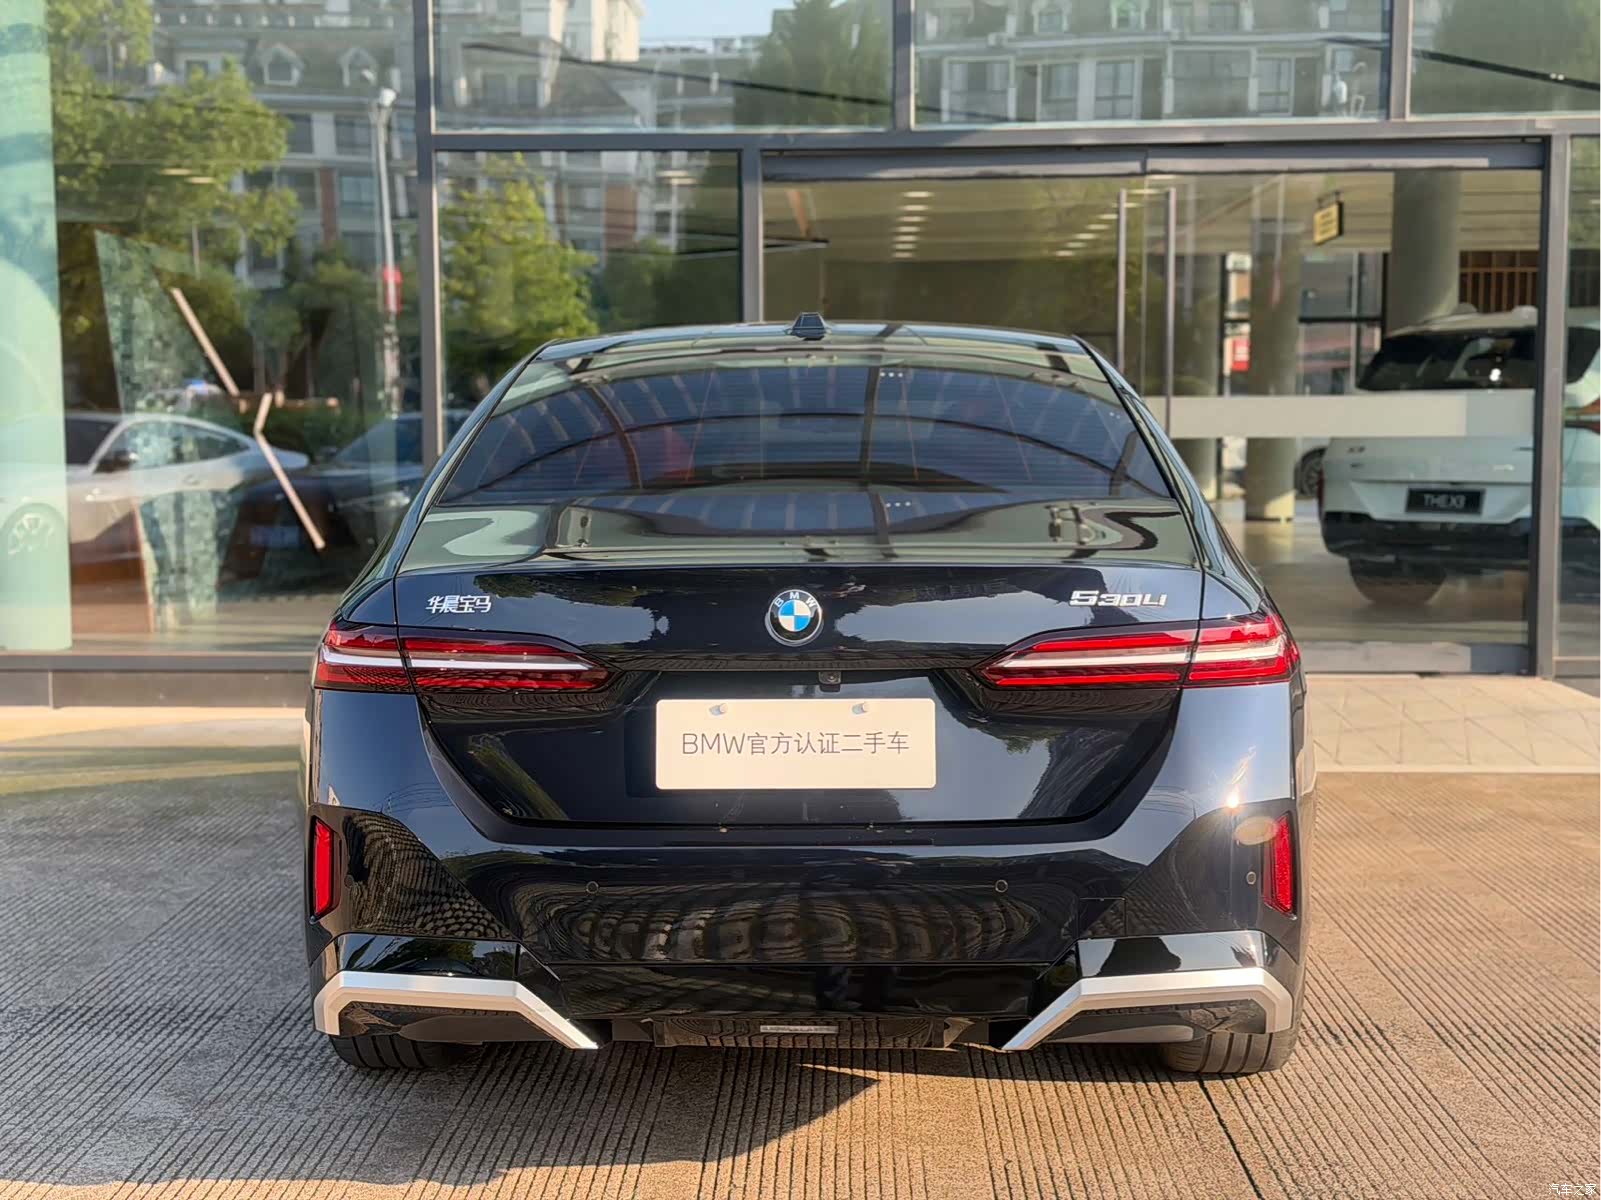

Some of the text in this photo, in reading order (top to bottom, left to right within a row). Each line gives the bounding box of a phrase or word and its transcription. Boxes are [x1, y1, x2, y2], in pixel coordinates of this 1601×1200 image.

[425, 594, 492, 614] 华晨宝马
[774, 591, 817, 608] BMW
[682, 731, 910, 755] BMW官方认证二手车
